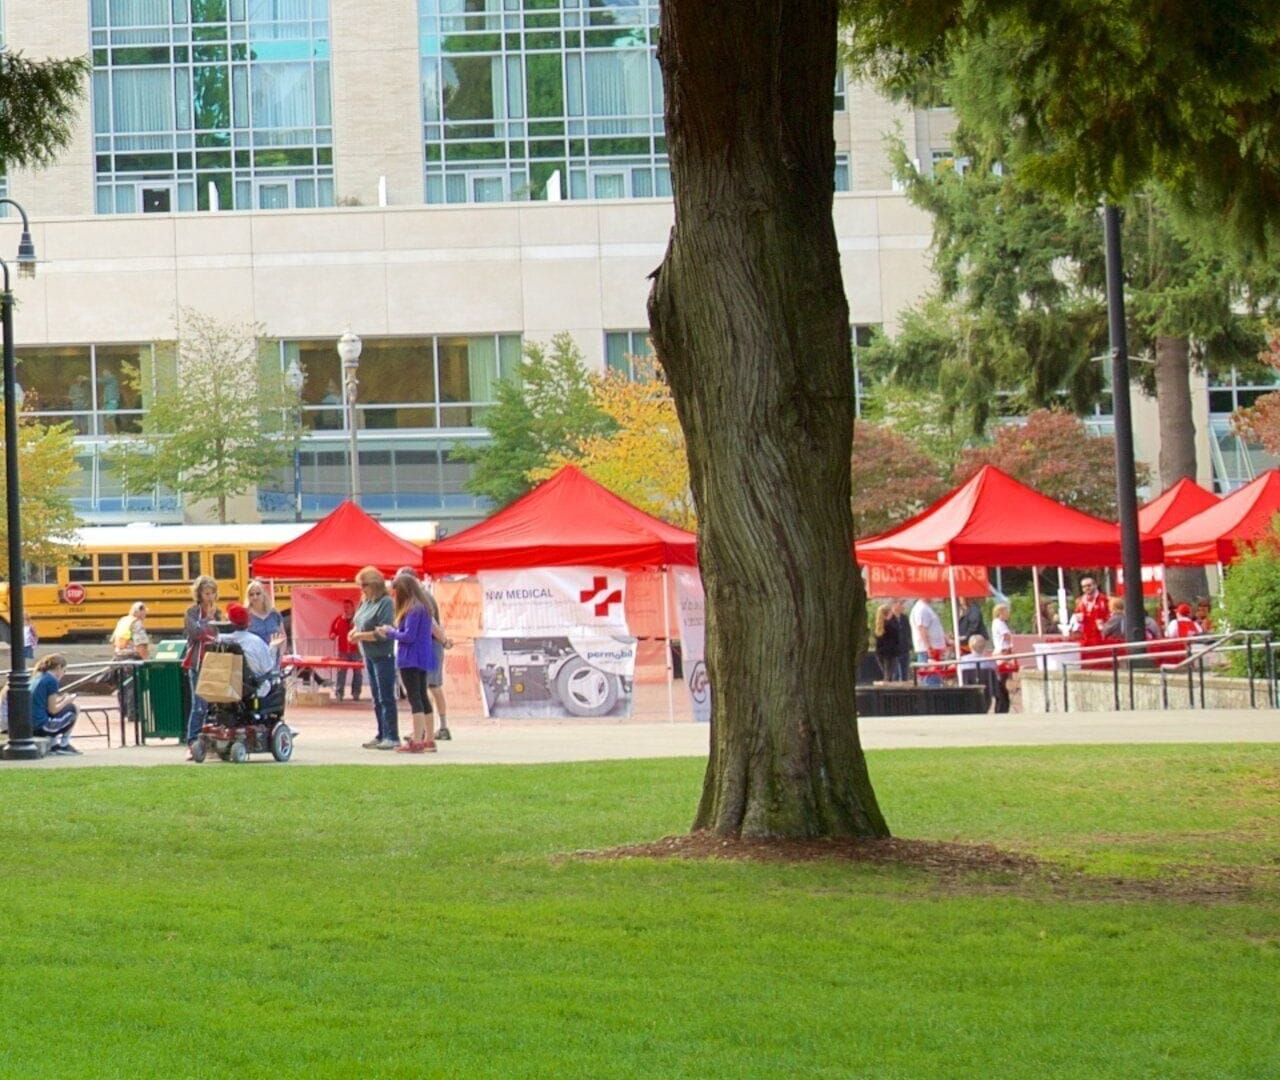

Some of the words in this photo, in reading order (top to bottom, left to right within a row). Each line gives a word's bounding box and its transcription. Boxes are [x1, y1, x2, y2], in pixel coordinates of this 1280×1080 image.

[67, 589, 84, 598] STOP
[486, 590, 504, 601] NW
[506, 588, 554, 600] MEDICAL
[587, 649, 633, 660] permobil
